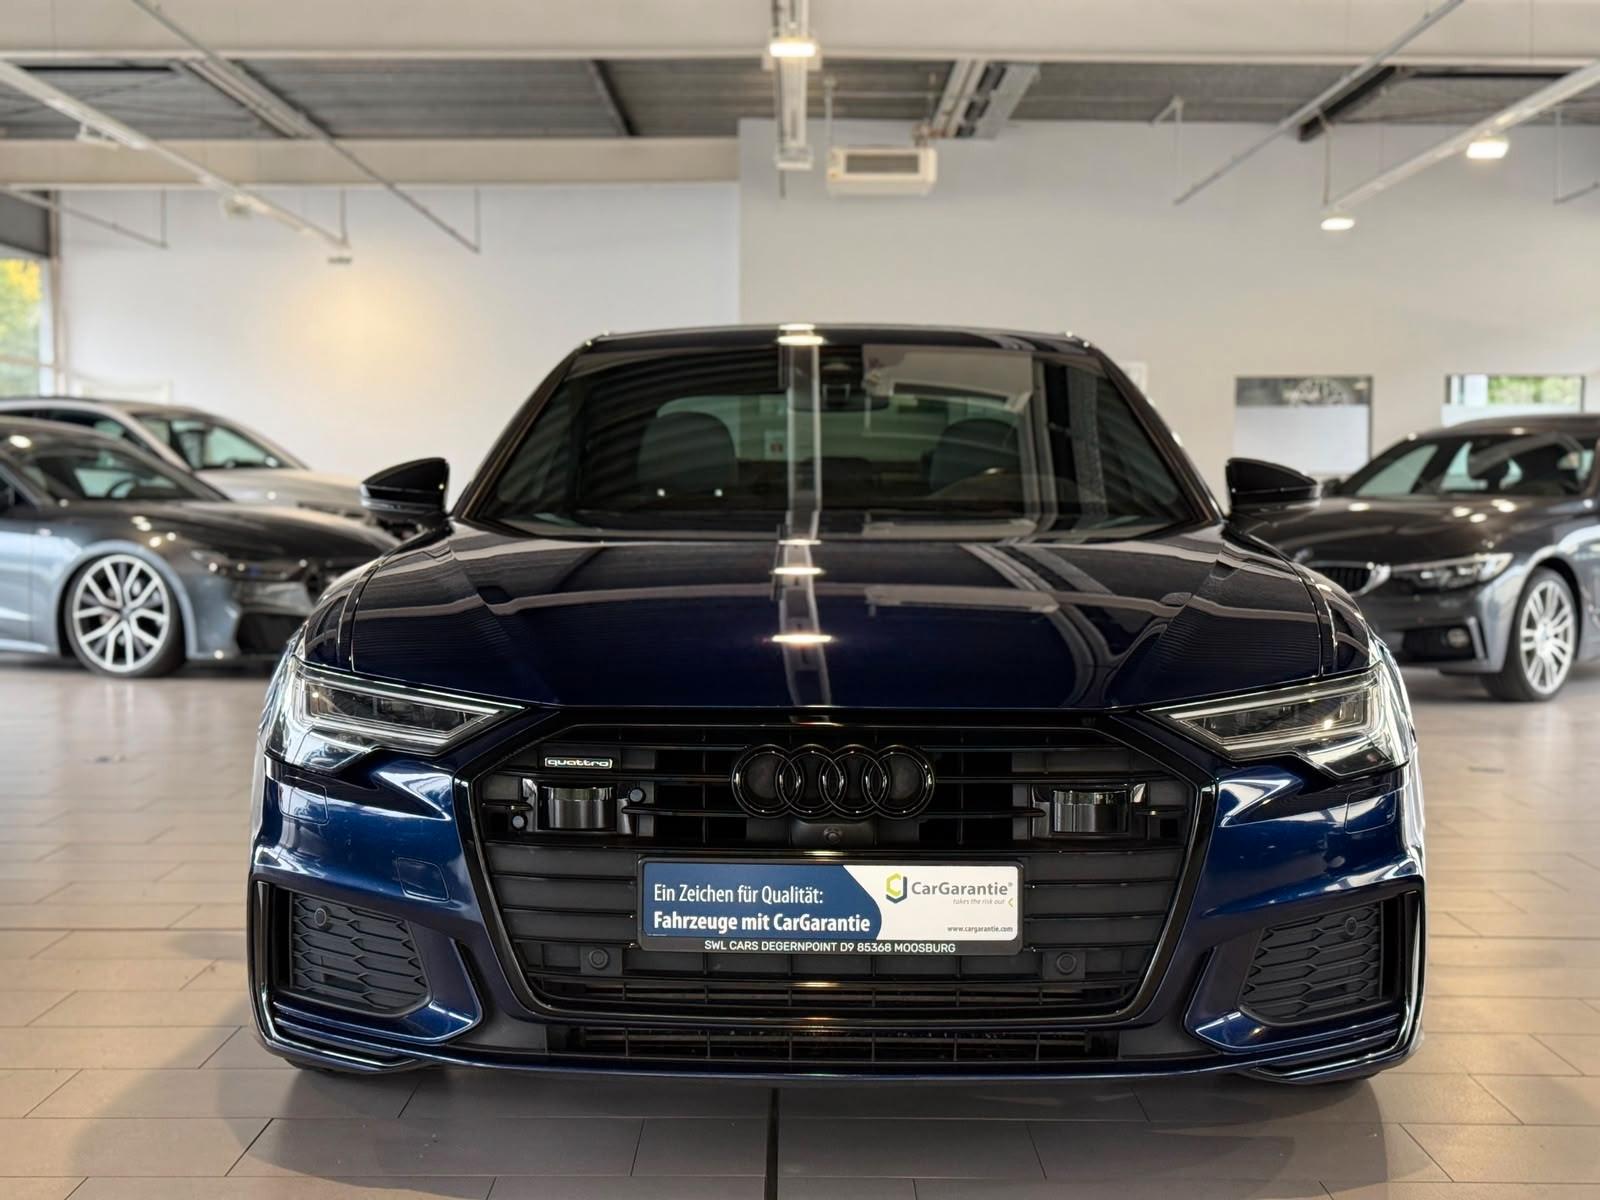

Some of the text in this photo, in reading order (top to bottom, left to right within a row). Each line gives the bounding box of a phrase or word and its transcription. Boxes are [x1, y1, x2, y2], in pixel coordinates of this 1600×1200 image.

[547, 758, 610, 768] quattro
[654, 884, 824, 905] Ein Zeichen für Qualität:
[653, 911, 871, 934] Fahrzeuge mit CarGarantie
[947, 925, 1014, 933] www.cargarantie.com
[704, 940, 956, 953] SWL CARS DEGERNPOINT D9 85368 MOOSBURG
